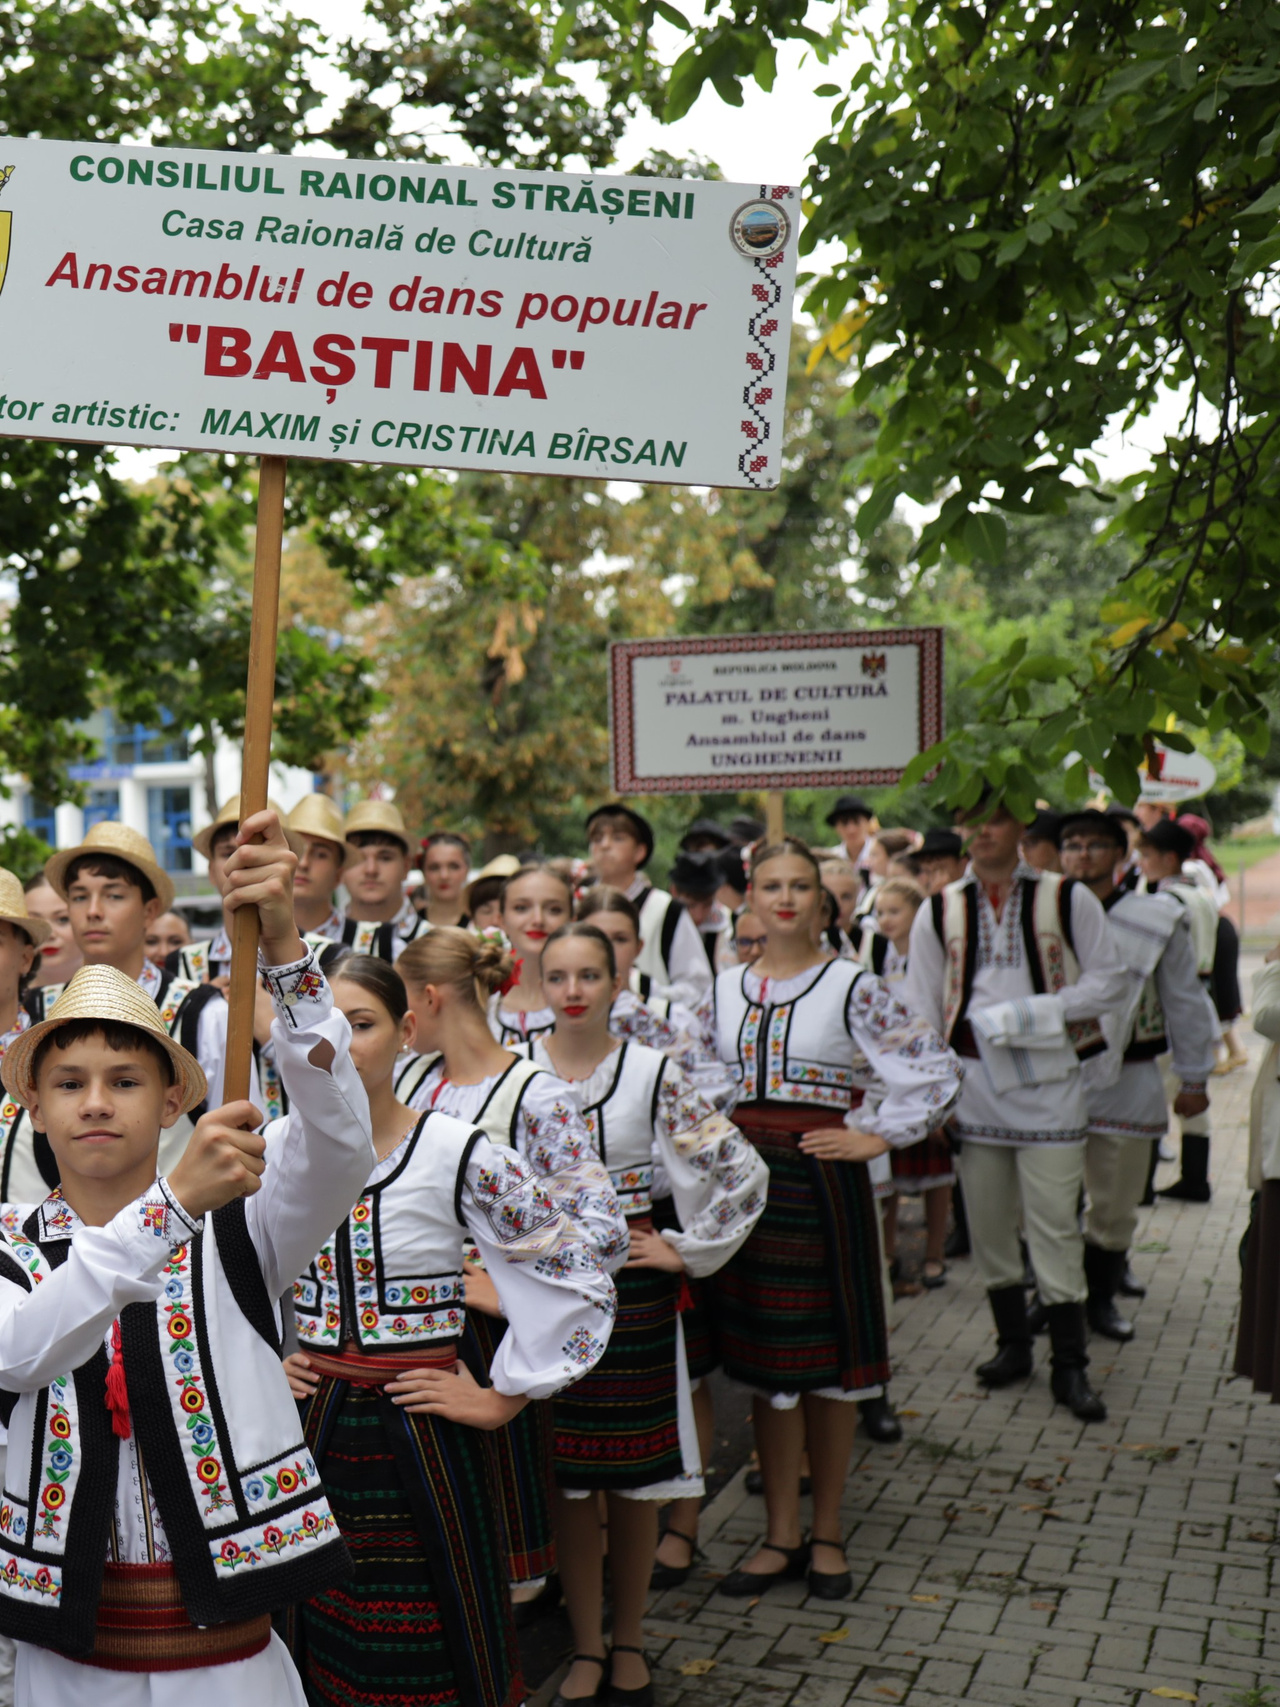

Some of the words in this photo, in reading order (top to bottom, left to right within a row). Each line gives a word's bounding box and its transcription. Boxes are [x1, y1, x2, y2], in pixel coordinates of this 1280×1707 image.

[70, 155, 285, 195] CONSILIUL
[299, 170, 478, 207] RAIONAL
[493, 180, 694, 225] STRĂȘENI
[162, 210, 244, 241] Casa
[256, 216, 403, 251] Raională
[415, 227, 456, 255] de
[469, 230, 591, 263] Cultură
[45, 251, 305, 304] Ansamblul
[317, 270, 373, 309] de
[389, 275, 503, 317] dans
[516, 290, 708, 333] popular
[169, 322, 585, 404] "BAȘTINA"
[52, 400, 179, 432] artistic:
[201, 408, 321, 442] MAXIM
[329, 419, 361, 453] și
[372, 421, 536, 458] CRISTINA
[547, 428, 687, 468] BÎRSAN
[664, 688, 754, 706] PALATUL
[760, 687, 787, 703] DE
[794, 682, 888, 701] CULTURĂ
[713, 663, 777, 676] REPUBLICA
[781, 660, 838, 673] MOLDOVA
[686, 729, 787, 748] Ansamblul
[792, 728, 815, 743] de
[821, 727, 867, 743] dans
[722, 711, 744, 725] m.
[751, 707, 830, 726] Ungheni
